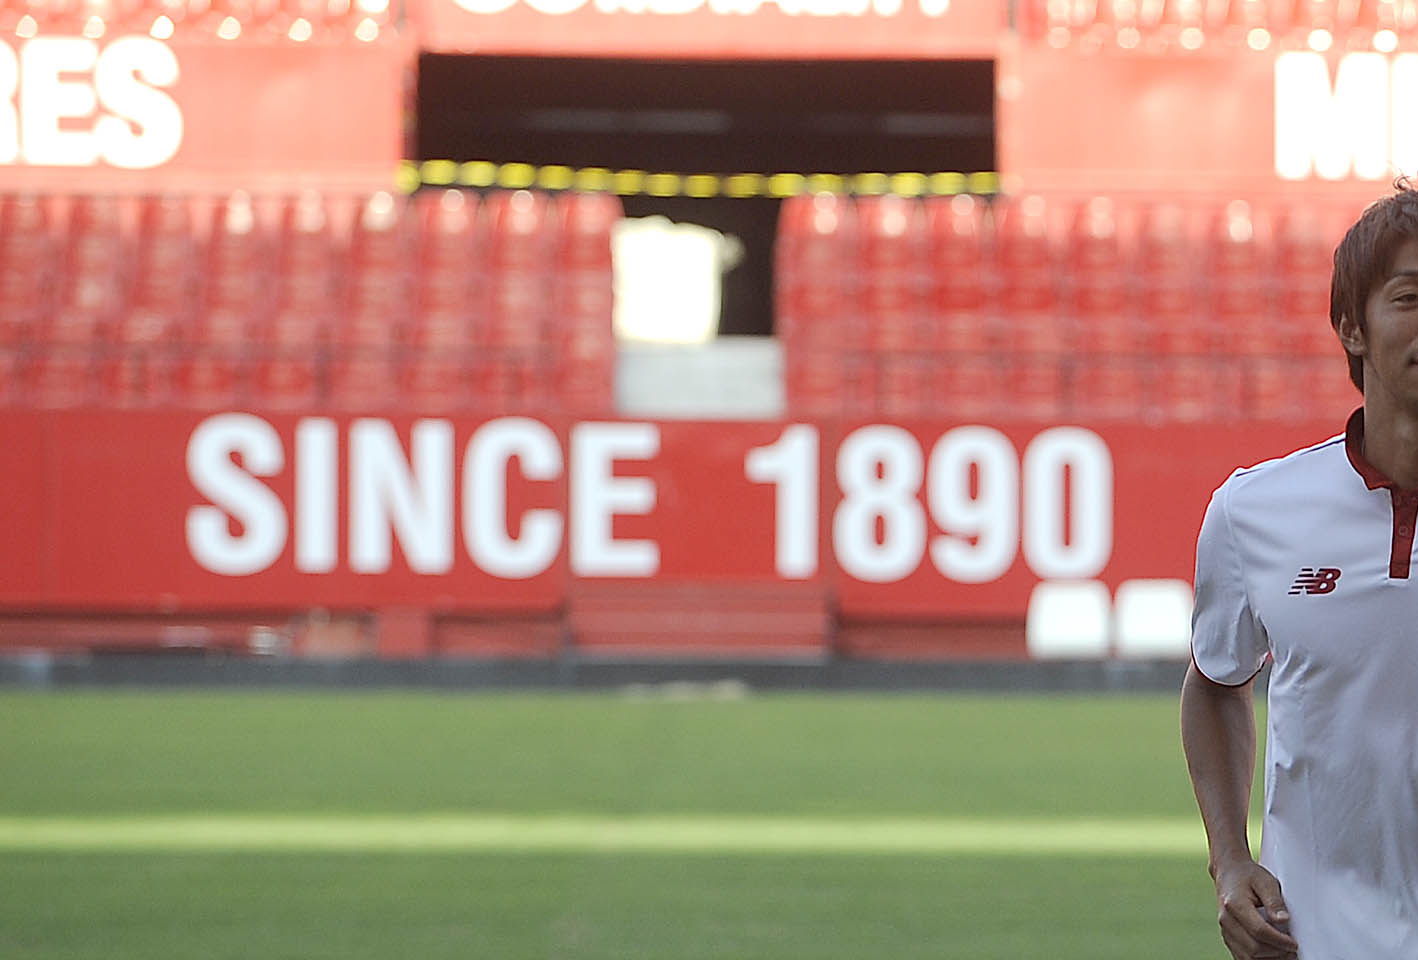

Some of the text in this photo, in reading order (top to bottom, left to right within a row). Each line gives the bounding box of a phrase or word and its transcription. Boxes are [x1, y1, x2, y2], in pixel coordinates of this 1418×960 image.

[0, 35, 184, 169] ES
[186, 412, 1114, 583] SINCE 1890
[1288, 567, 1342, 595] NB
